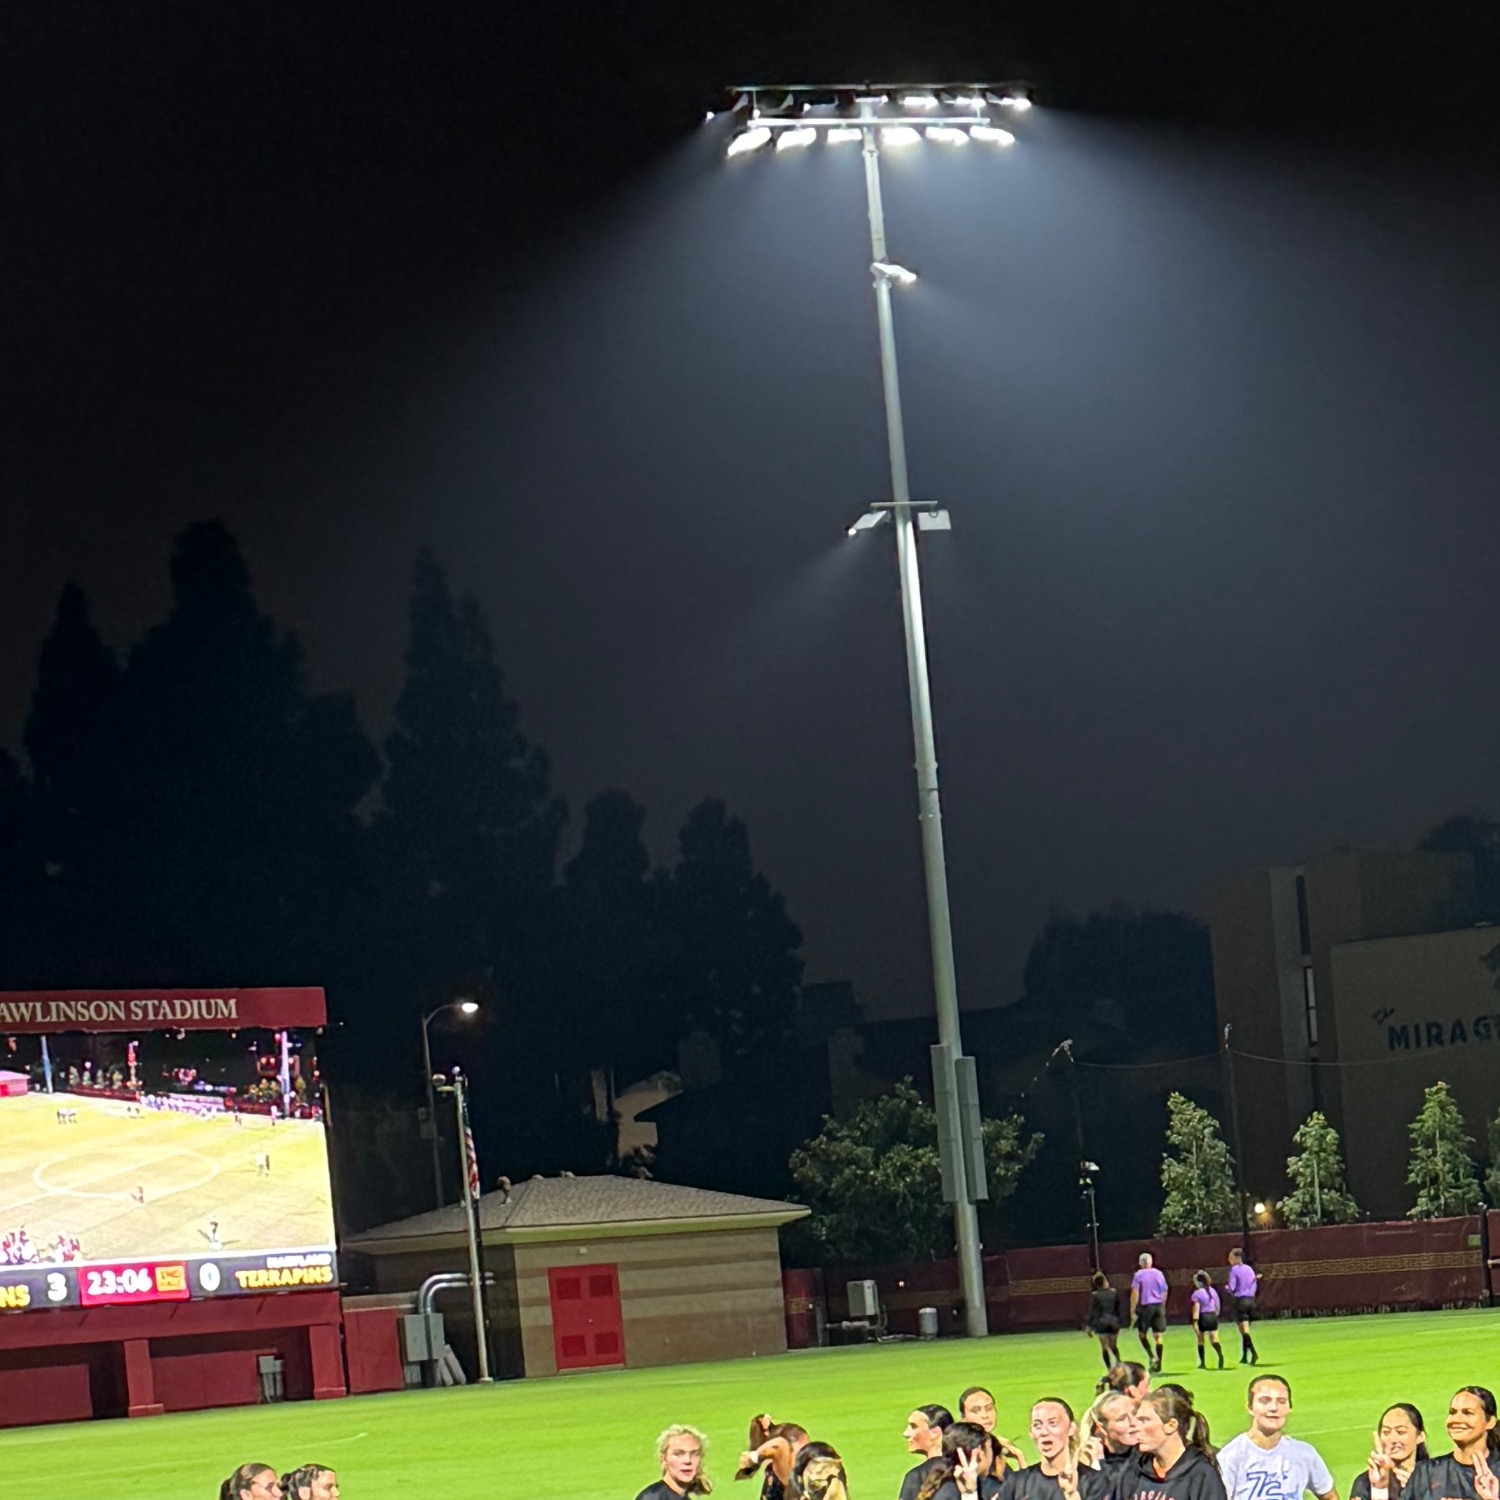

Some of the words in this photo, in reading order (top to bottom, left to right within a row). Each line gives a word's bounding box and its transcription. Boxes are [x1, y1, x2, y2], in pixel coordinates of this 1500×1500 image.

[130, 999, 238, 1020] STADIUM
[47, 1272, 68, 1302] 3
[87, 1268, 153, 1296] 23:06
[200, 1262, 220, 1292] 0
[235, 1266, 333, 1289] TERRAPINS
